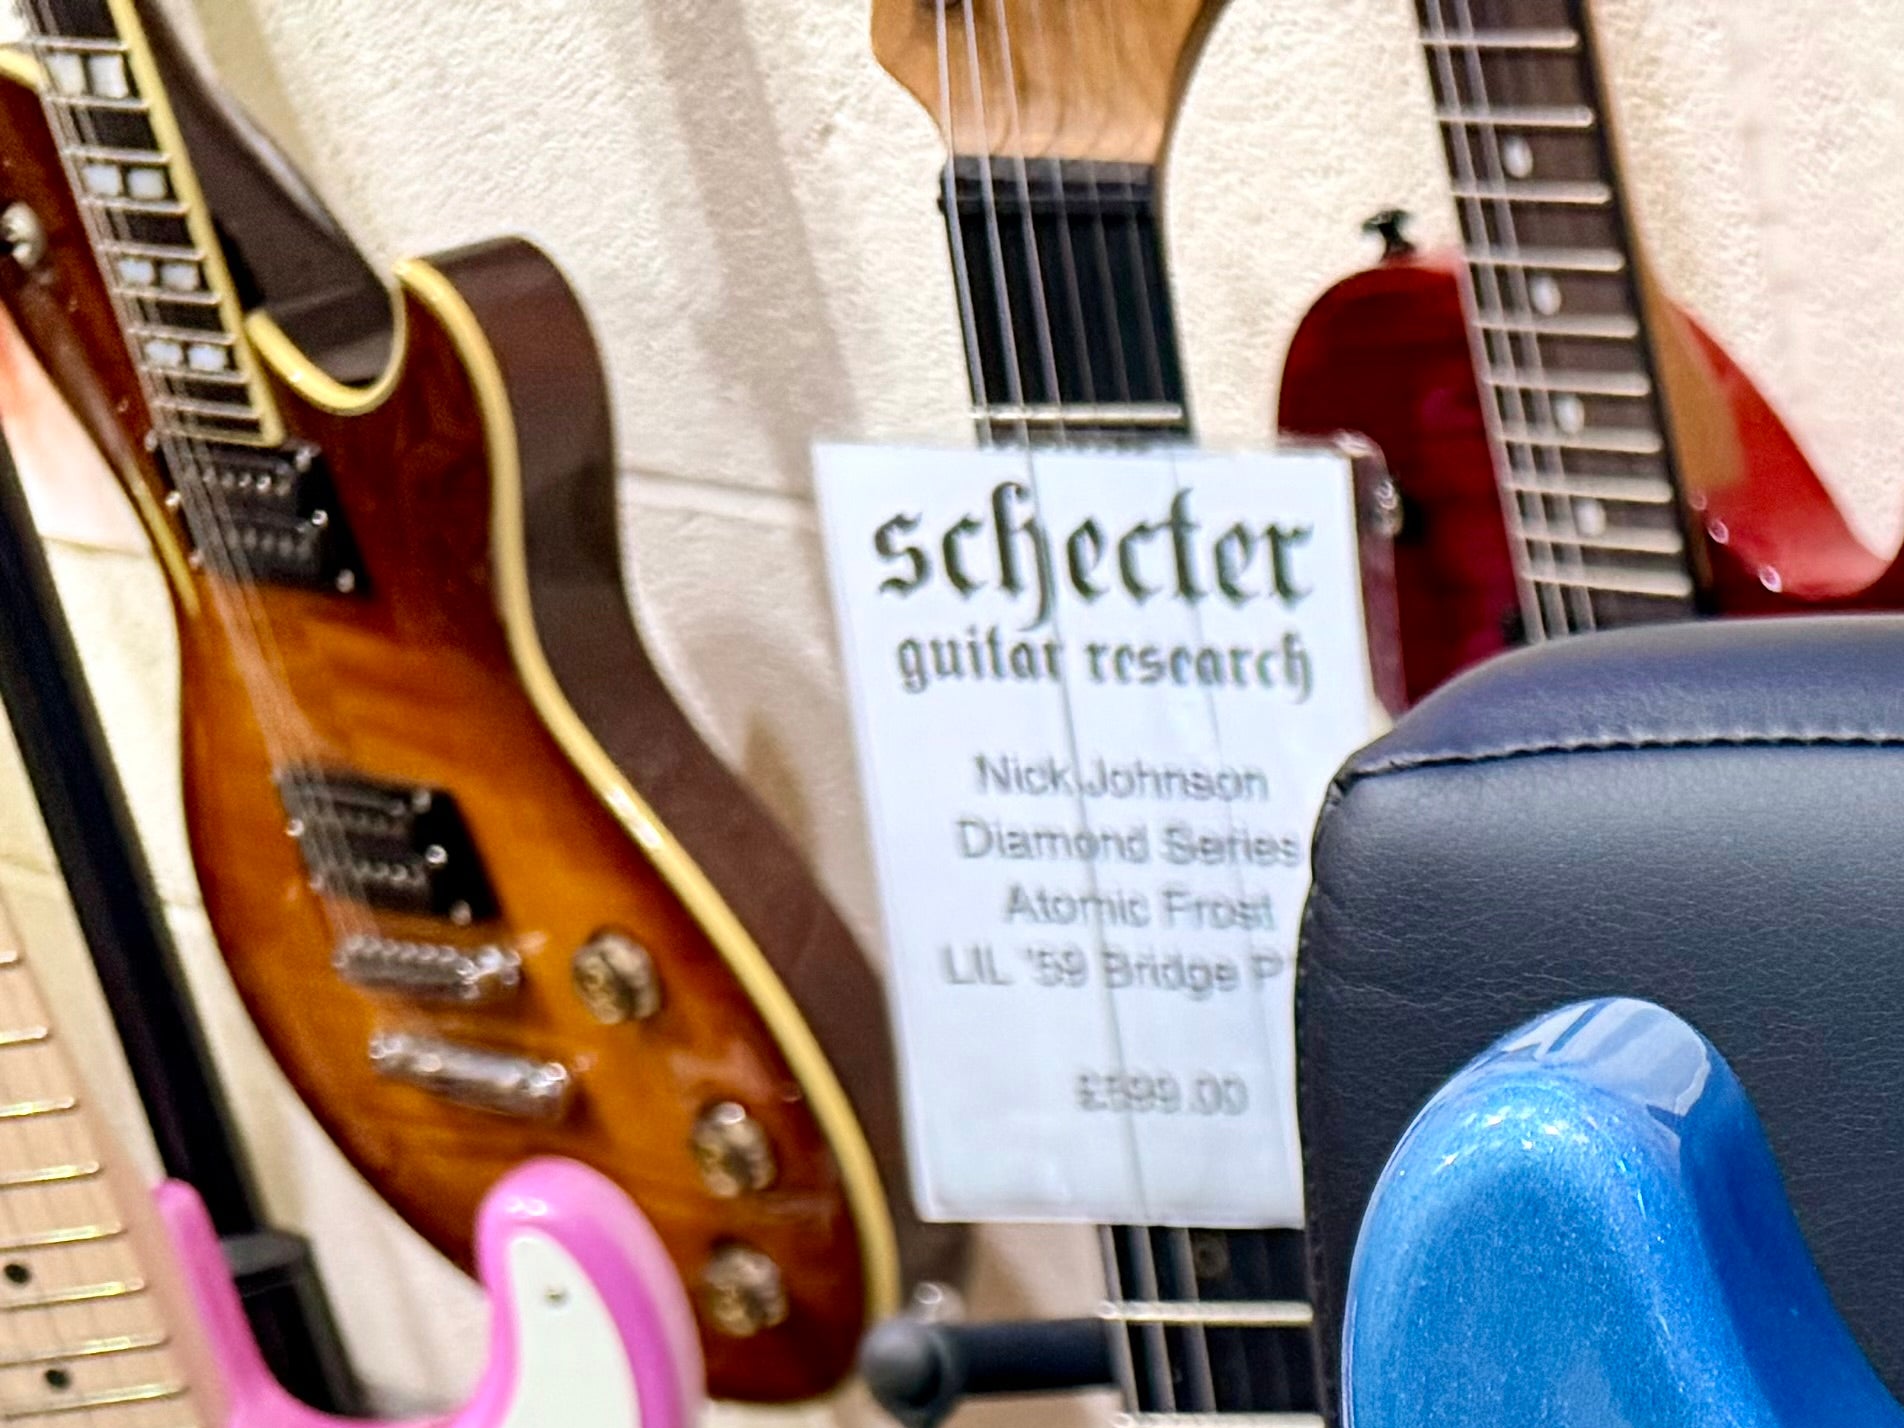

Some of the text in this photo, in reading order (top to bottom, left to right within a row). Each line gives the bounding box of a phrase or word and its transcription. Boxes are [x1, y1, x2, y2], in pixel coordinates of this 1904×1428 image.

[874, 481, 1314, 632] schecter
[898, 625, 1314, 704] guitar research
[974, 752, 1269, 800] Nick Johnson
[956, 816, 1300, 867] Diamond Series
[1004, 883, 1276, 929] Atomic Frost
[1102, 947, 1242, 1001] Bridge
[1250, 950, 1284, 992] P
